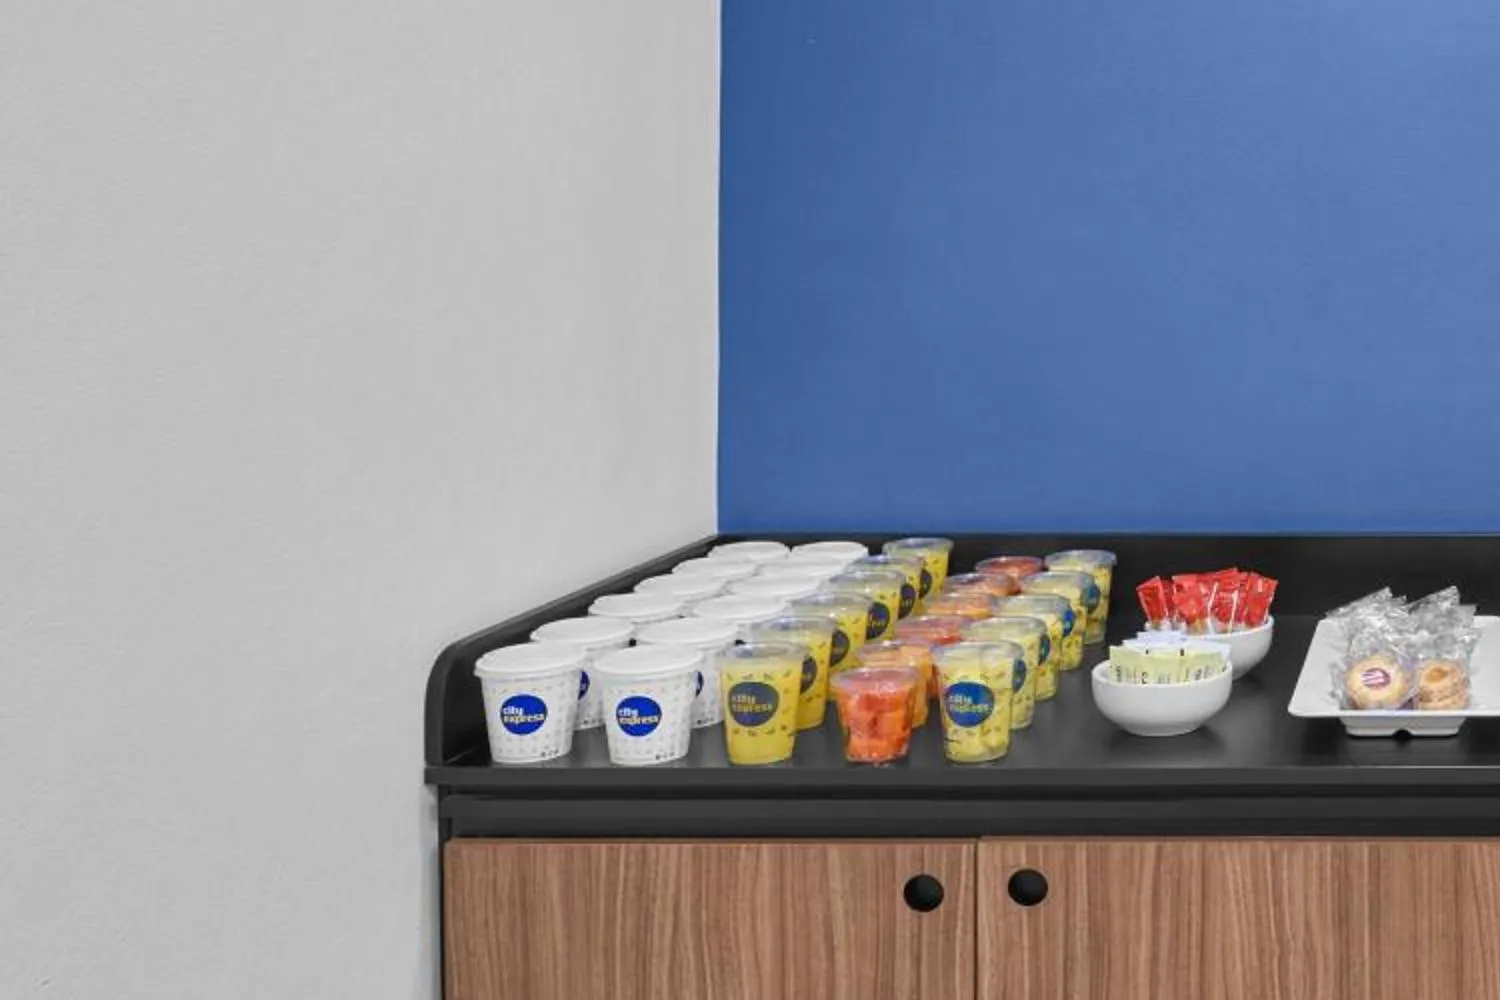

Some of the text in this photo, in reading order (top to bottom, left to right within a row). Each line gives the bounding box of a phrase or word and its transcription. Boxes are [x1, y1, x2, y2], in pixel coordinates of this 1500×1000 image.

[503, 705, 524, 715] city
[618, 707, 639, 717] city
[503, 714, 545, 724] express
[619, 716, 659, 725] express
